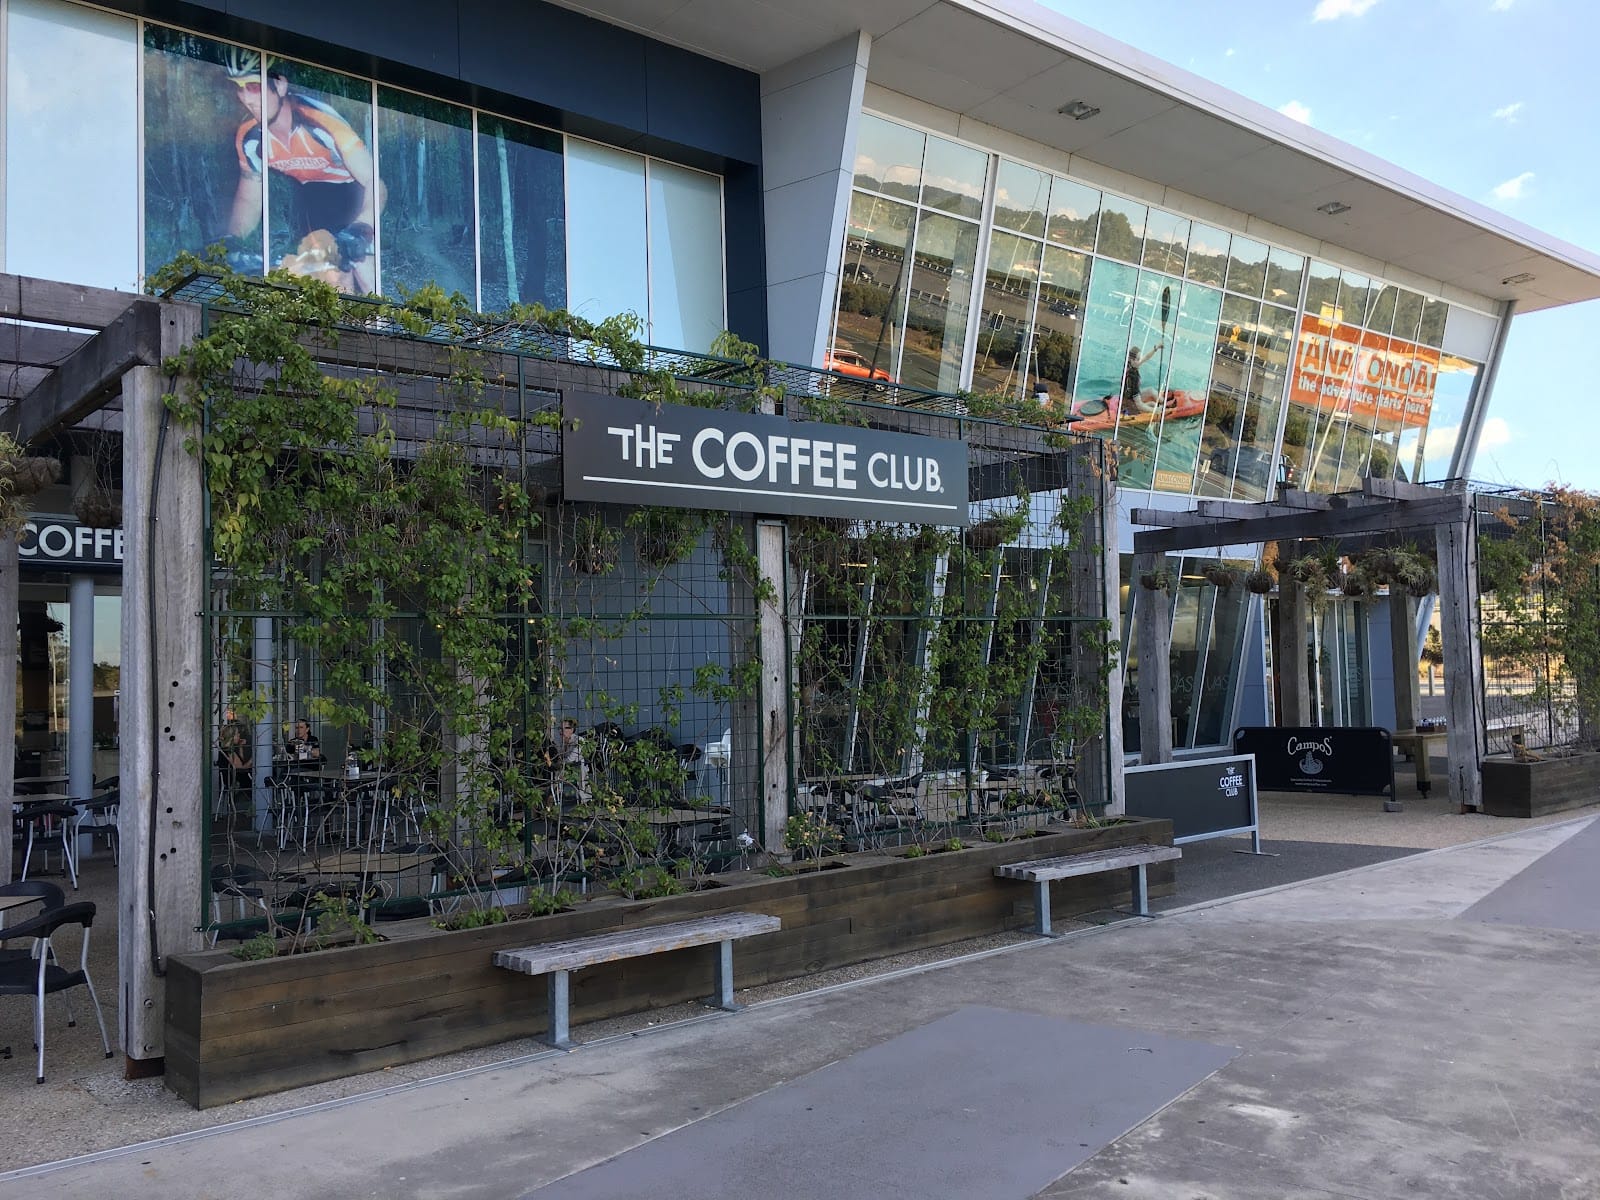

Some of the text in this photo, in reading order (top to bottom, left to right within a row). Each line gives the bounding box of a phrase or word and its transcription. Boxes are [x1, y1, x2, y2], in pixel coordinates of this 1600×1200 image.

[1298, 375, 1317, 392] the
[607, 423, 681, 469] THE
[692, 428, 857, 490] COFFEE
[1219, 775, 1243, 788] COFFEE
[1225, 788, 1239, 798] CLUB
